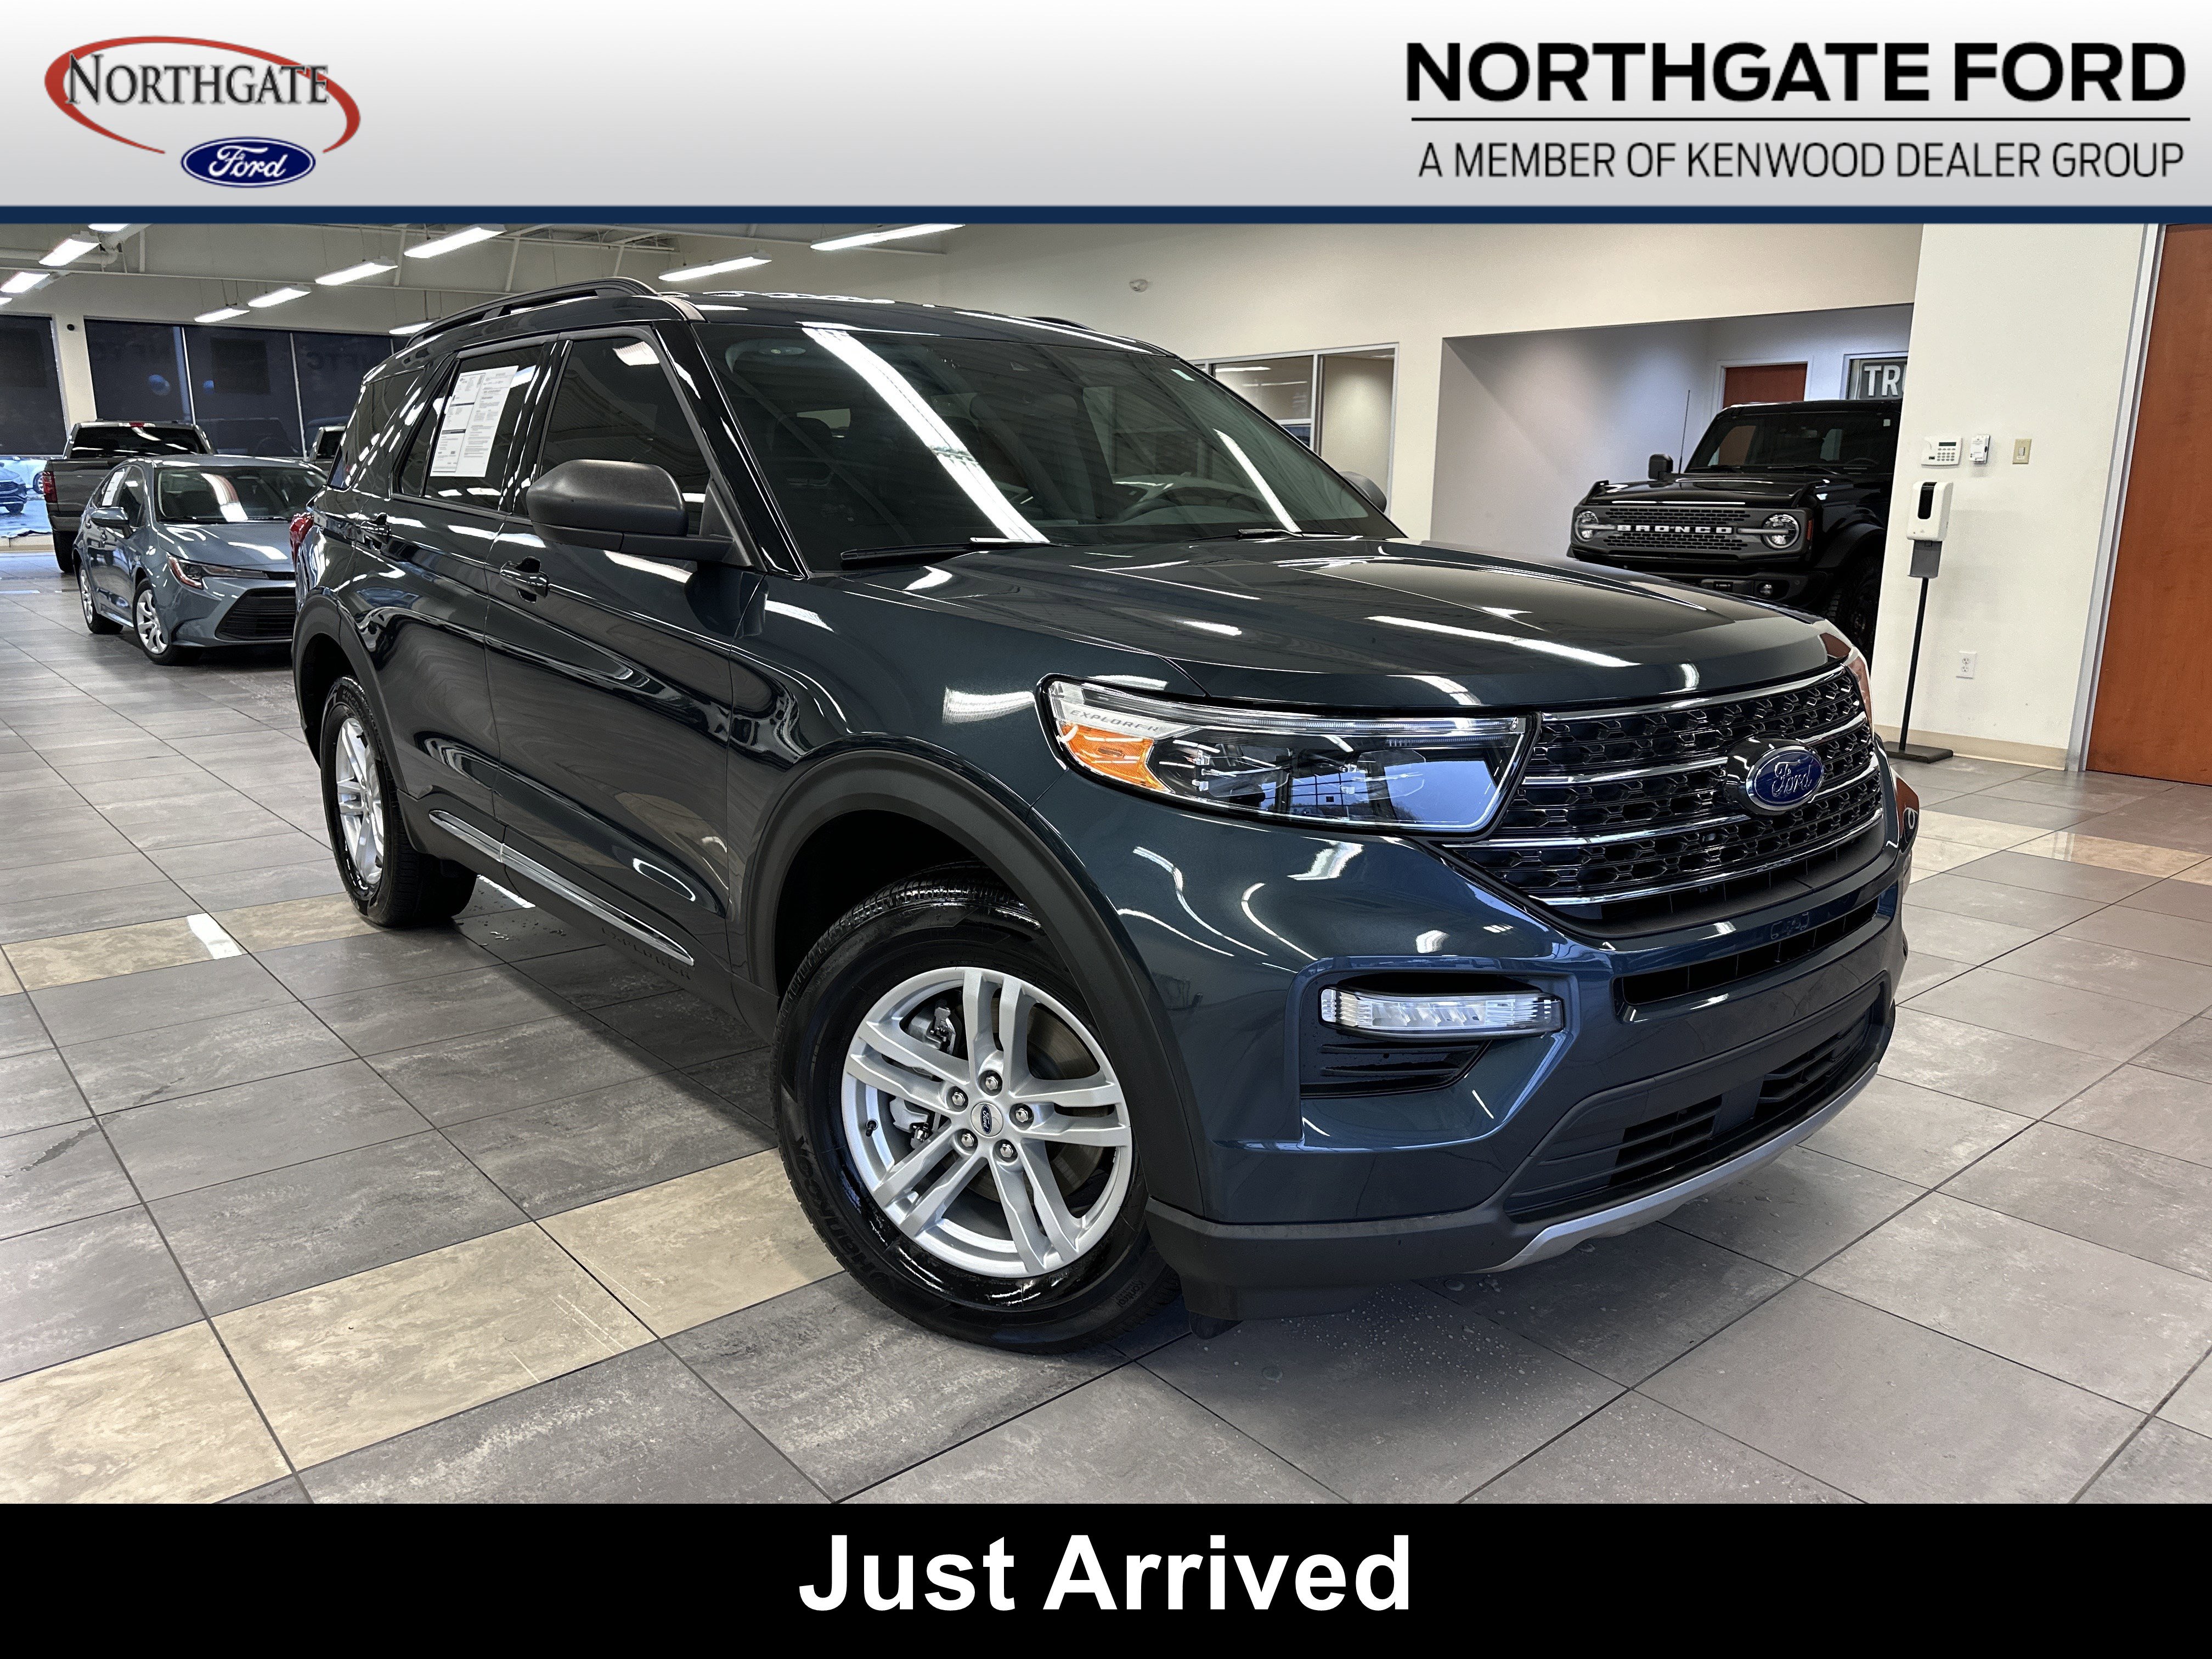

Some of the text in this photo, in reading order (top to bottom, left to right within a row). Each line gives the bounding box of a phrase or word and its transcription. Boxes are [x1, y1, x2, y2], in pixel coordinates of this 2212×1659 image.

[1864, 365, 1906, 396] TR
[1617, 524, 1733, 534] BRONCO
[1771, 759, 1813, 798] Ford
[982, 1110, 991, 1129] Ford
